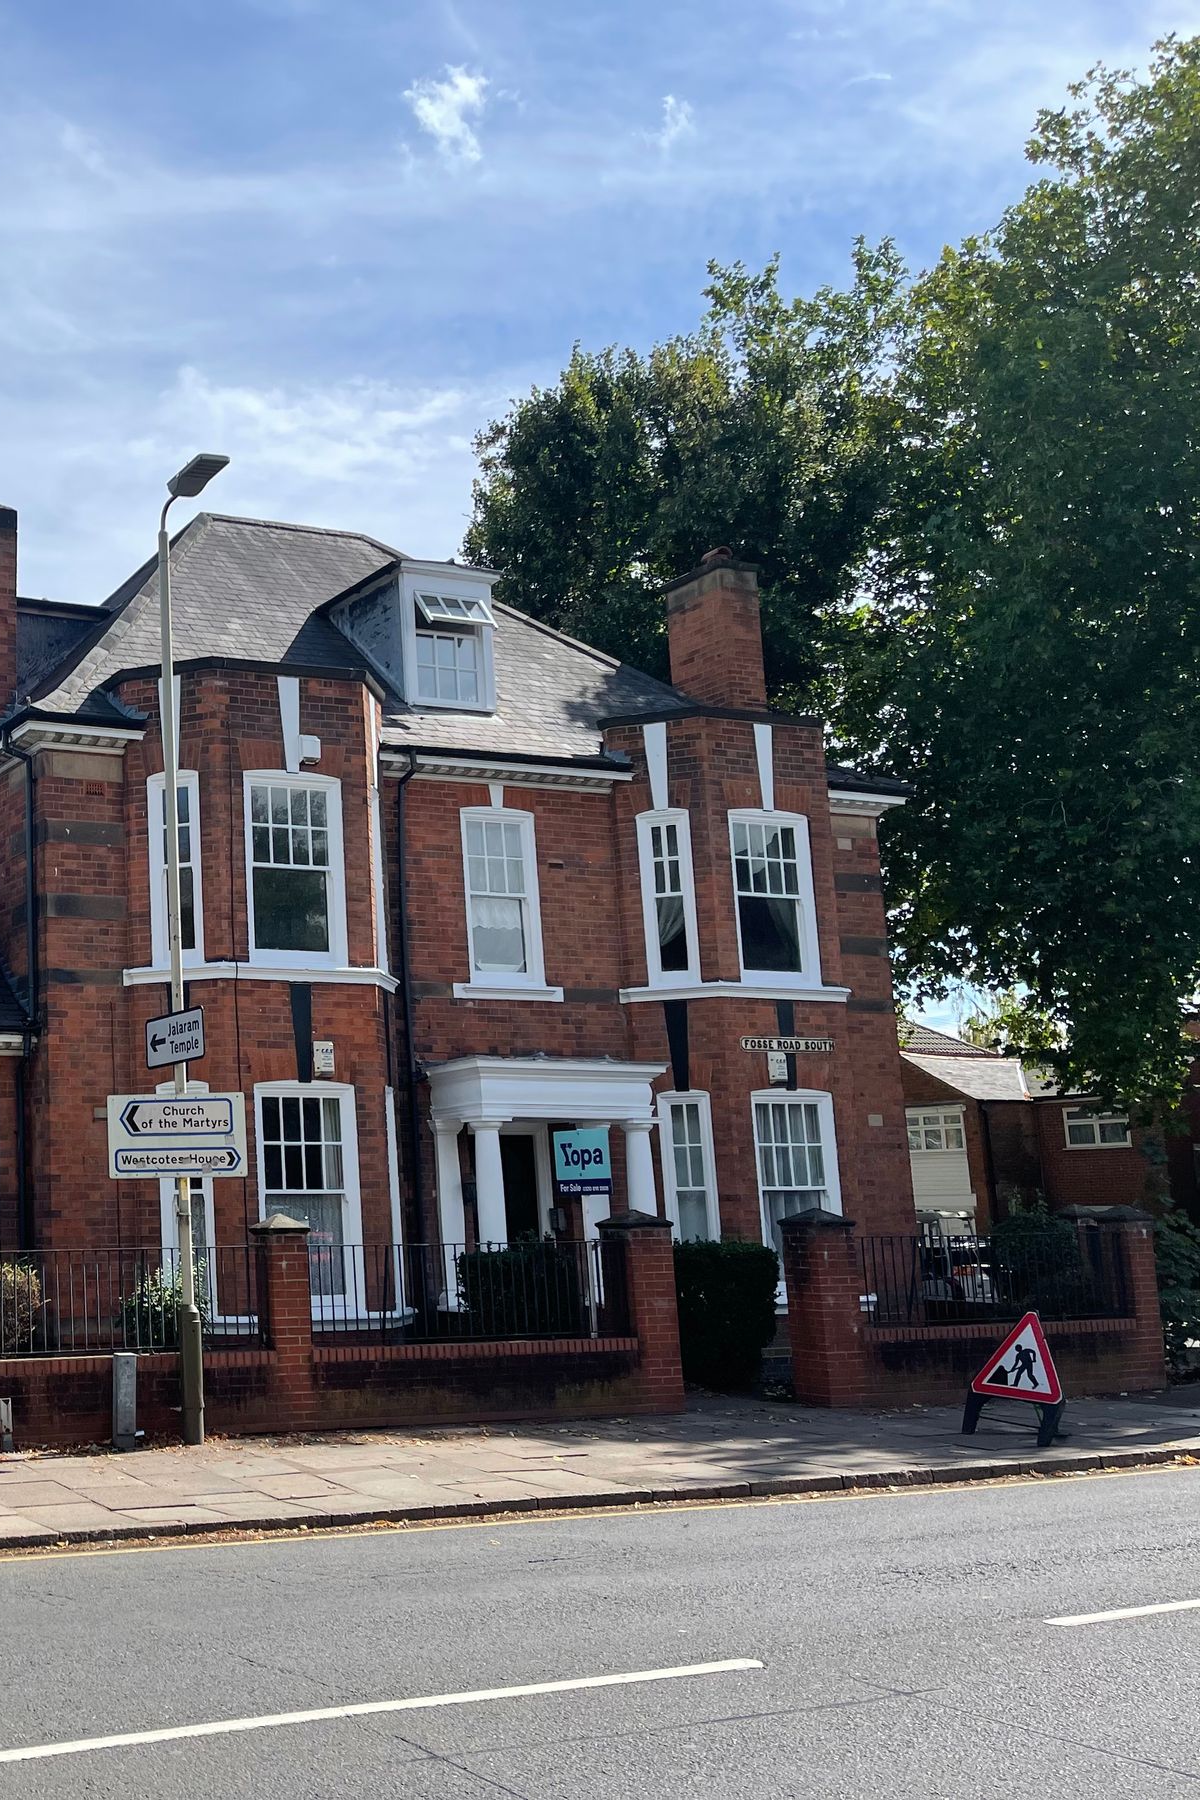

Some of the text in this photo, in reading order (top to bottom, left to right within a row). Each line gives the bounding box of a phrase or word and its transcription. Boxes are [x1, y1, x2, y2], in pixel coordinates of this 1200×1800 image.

[168, 1019, 200, 1037] Jalaram
[170, 1036, 199, 1054] Temple
[744, 1039, 835, 1051] FOSSE ROAD SOUTH
[162, 1105, 205, 1116] Church
[141, 1117, 229, 1130] of the Martyrs
[560, 1143, 603, 1170] Yopa
[560, 1184, 569, 1192] For
[570, 1183, 582, 1192] Sale
